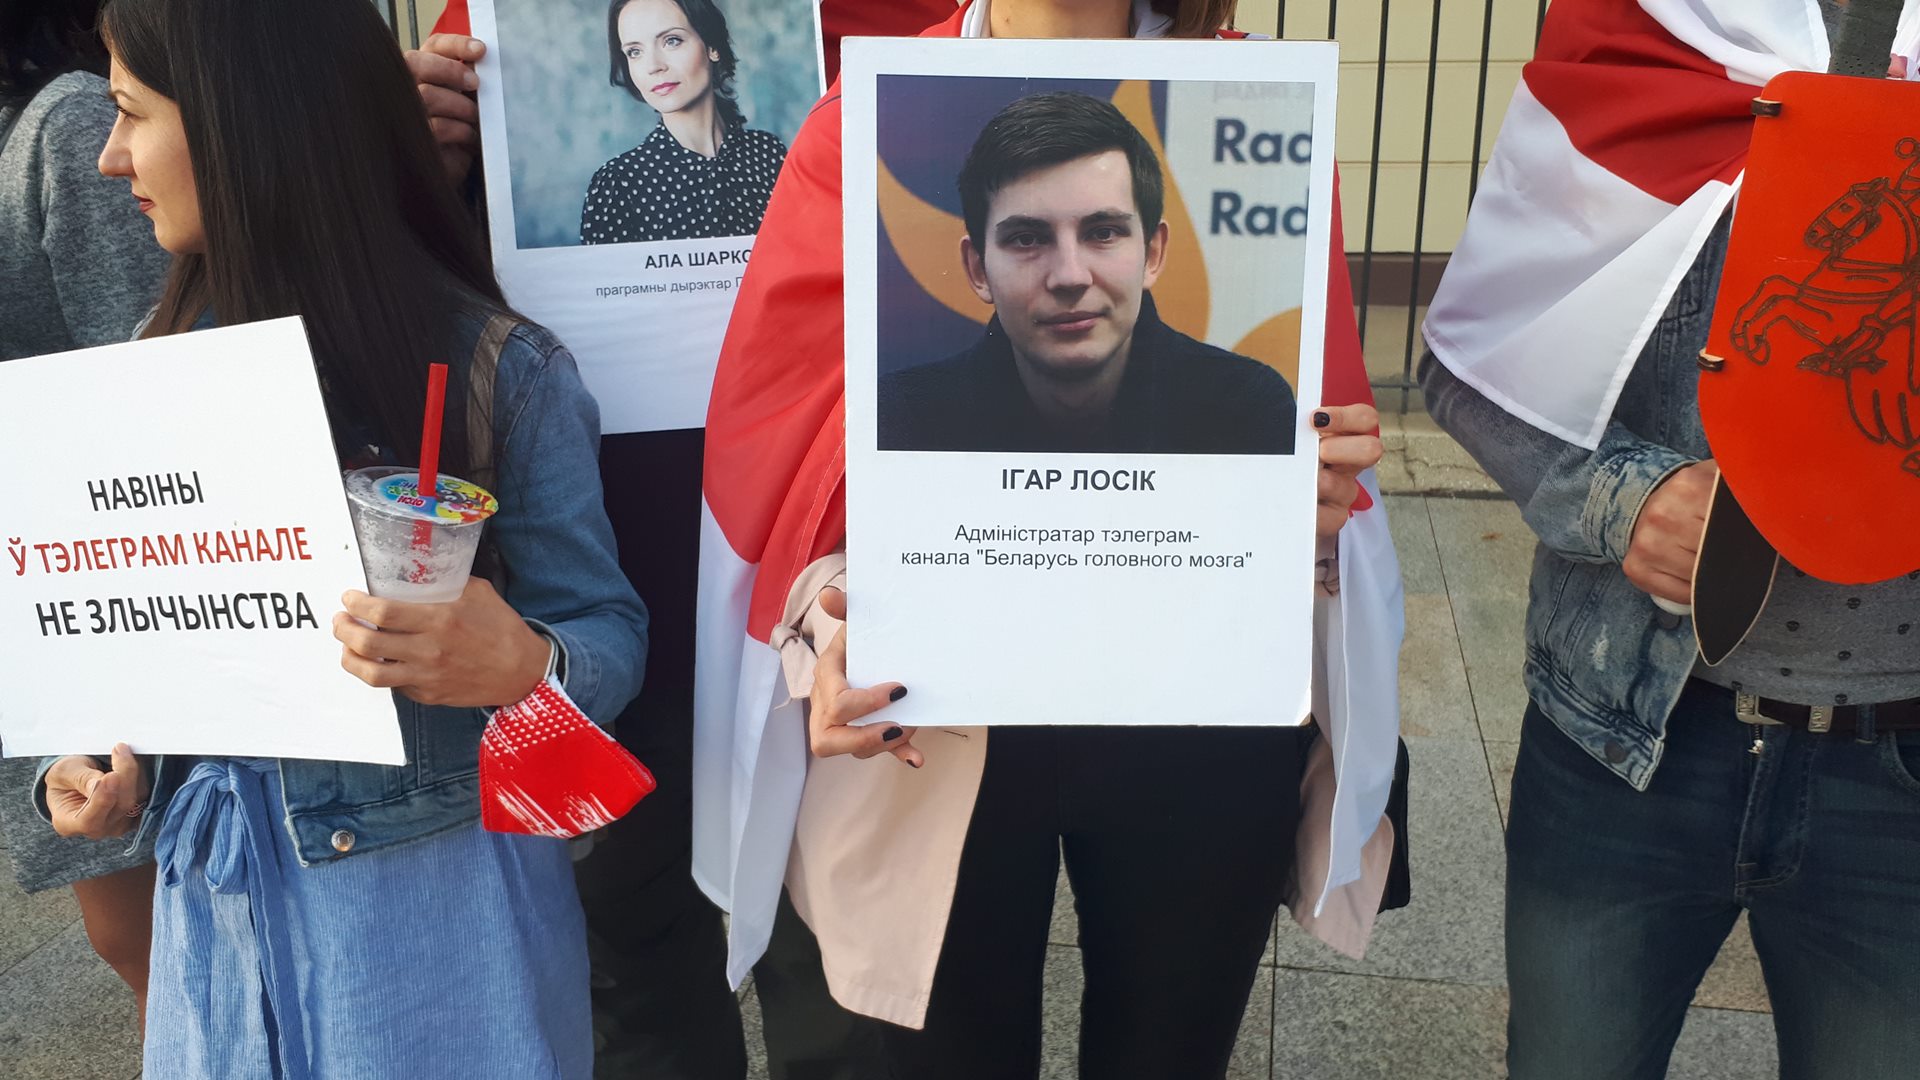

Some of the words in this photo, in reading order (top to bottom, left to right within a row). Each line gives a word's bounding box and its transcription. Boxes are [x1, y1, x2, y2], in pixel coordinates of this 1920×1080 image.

[645, 254, 684, 269] АЛА
[595, 284, 667, 298] праграмны
[670, 279, 732, 294] дырэктар
[88, 471, 205, 511] НАВІНЫ
[1001, 468, 1063, 491] ІГАР
[1070, 469, 1156, 492] ЛОСІК
[954, 524, 1095, 546] Адміністратар
[1101, 529, 1200, 547] тэлеграм-
[8, 537, 27, 577] Ў
[34, 532, 188, 574] ТЭЛЕГРАМ
[192, 527, 313, 565] КАНАЛЕ
[901, 551, 970, 566] канала
[976, 548, 1079, 570] "Беларусь
[1084, 553, 1183, 568] головного
[1189, 551, 1253, 568] мозга"
[35, 600, 82, 637] НЕ
[86, 592, 319, 635] ЗЛЫЧЫНСТВА
